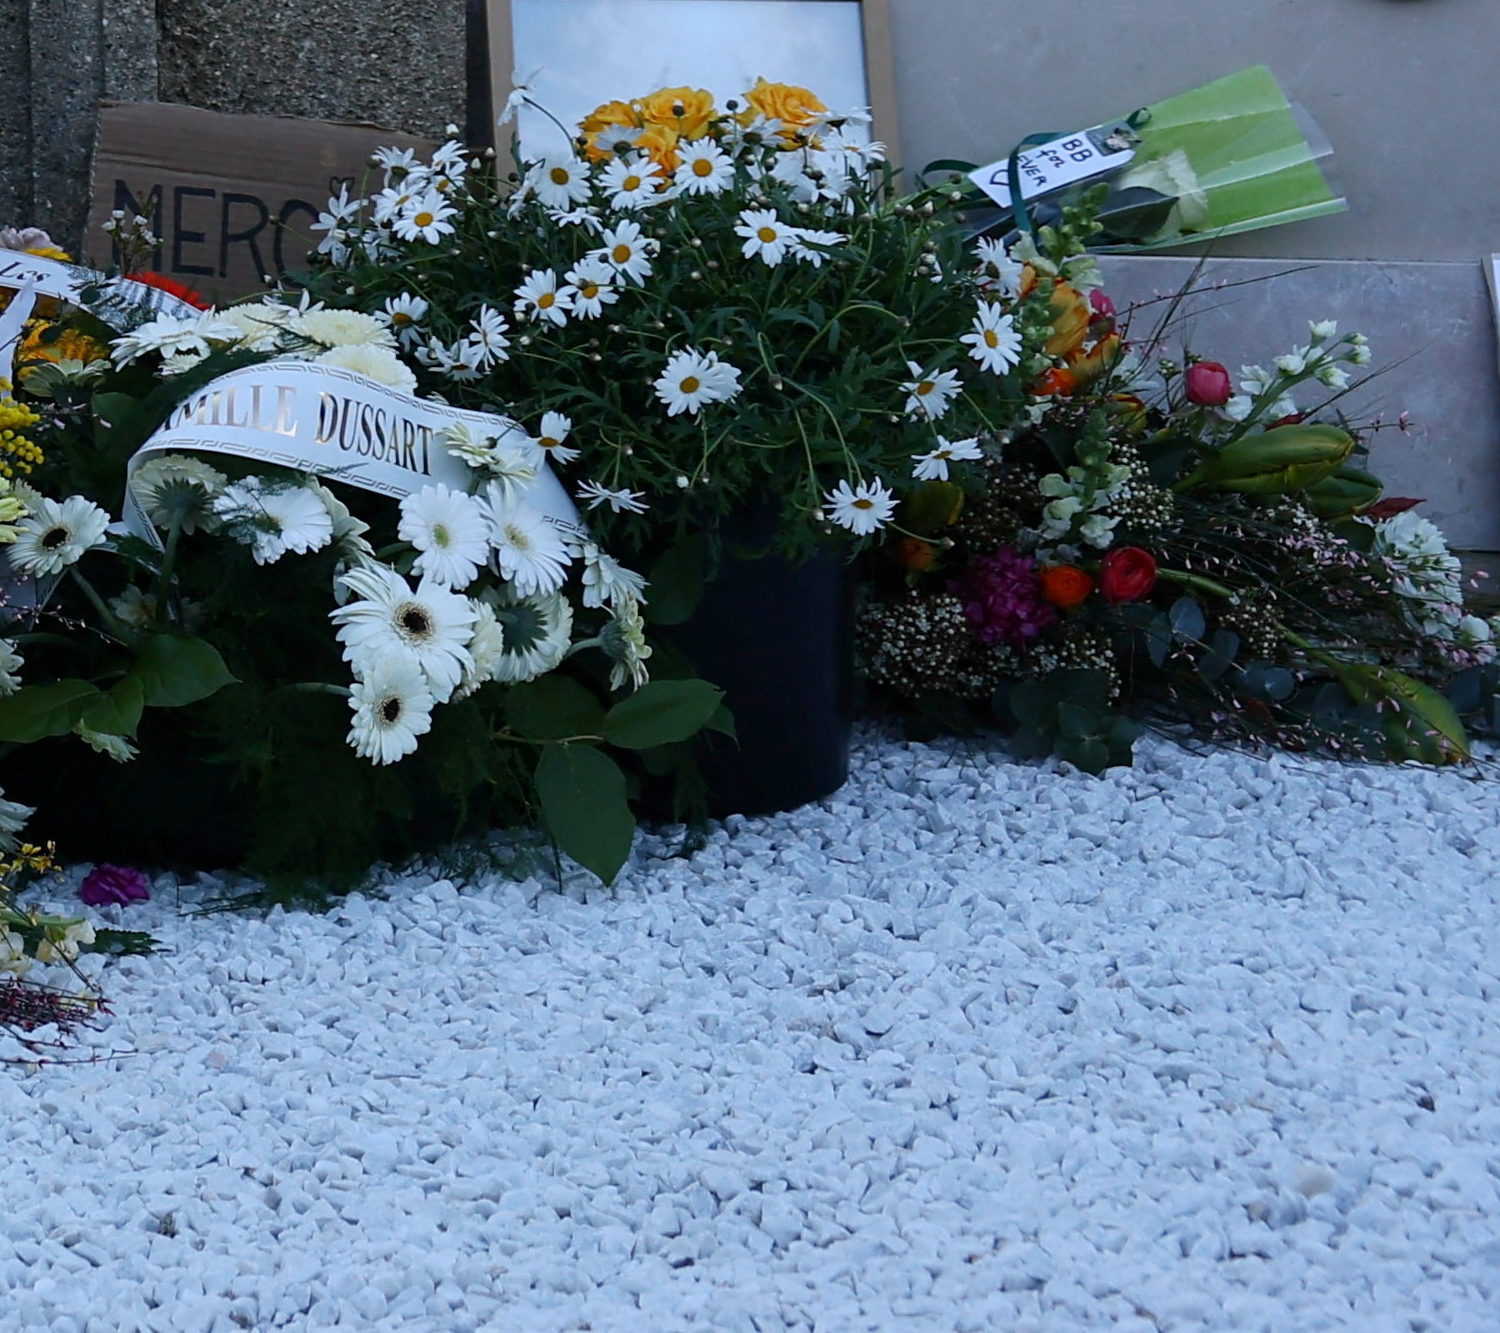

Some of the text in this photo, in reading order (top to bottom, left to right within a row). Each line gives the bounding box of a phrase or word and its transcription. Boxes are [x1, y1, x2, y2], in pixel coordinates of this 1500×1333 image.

[1062, 138, 1094, 163] BB
[111, 179, 322, 288] MERC
[313, 391, 435, 477] DUSSART
